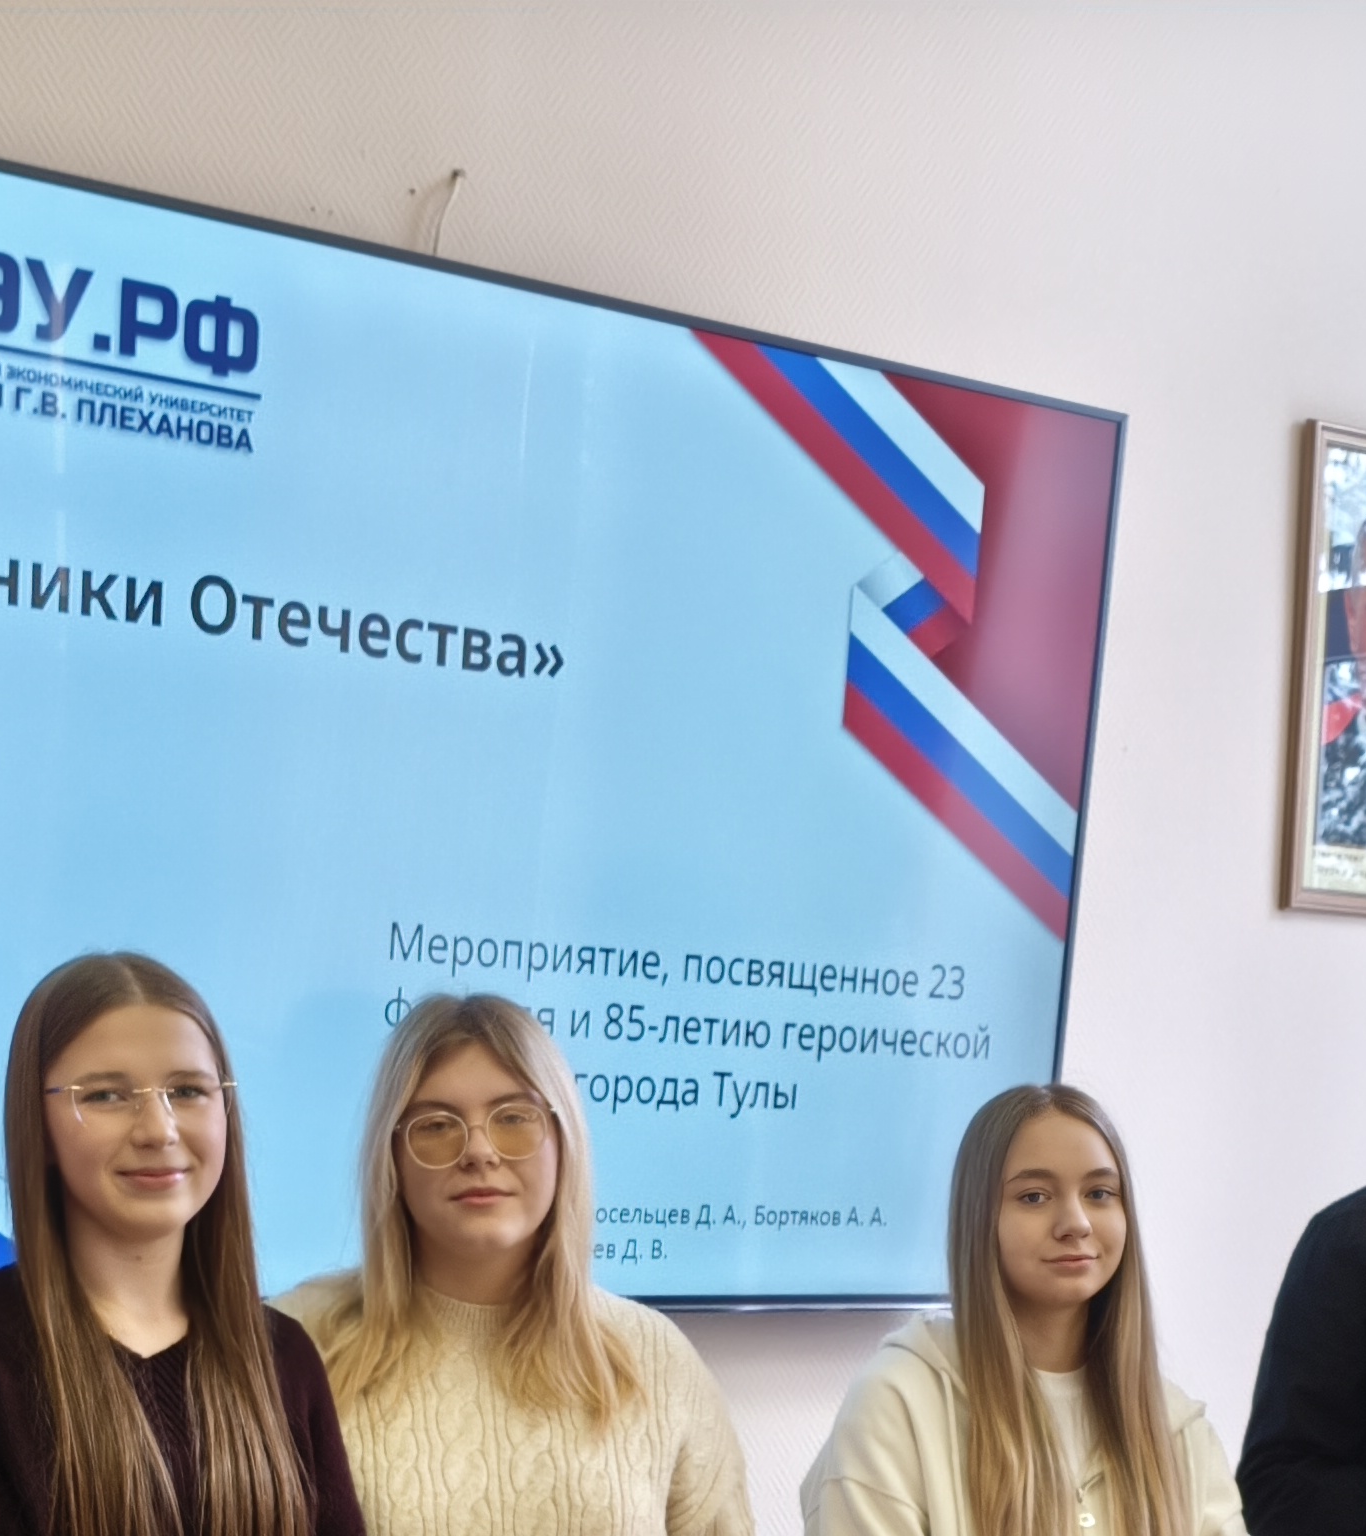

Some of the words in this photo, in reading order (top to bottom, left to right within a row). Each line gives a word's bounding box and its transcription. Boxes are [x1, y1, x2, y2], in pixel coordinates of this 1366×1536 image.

[5, 364, 144, 402] ЭКОНОМИЧЕСКИЙ
[148, 390, 256, 424] УНИВЕРСИТЕТ
[14, 388, 67, 420] Г.В.
[77, 398, 254, 453] ПЛЕХАНОВА
[190, 573, 566, 679] Отечества»
[388, 921, 669, 987] Мероприятие,
[684, 953, 920, 997] посвященное
[928, 963, 966, 1001] 23
[570, 1009, 591, 1039] и
[603, 1002, 771, 1048] 85-летию
[782, 1021, 991, 1063] героической
[712, 1071, 799, 1119] Тулы
[595, 1205, 691, 1229] осельцев
[695, 1203, 717, 1231] Д.
[753, 1204, 842, 1232] Бортяков
[846, 1205, 865, 1228] А.
[869, 1206, 888, 1228] А.
[621, 1238, 643, 1265] Д.
[650, 1238, 668, 1261] В.
